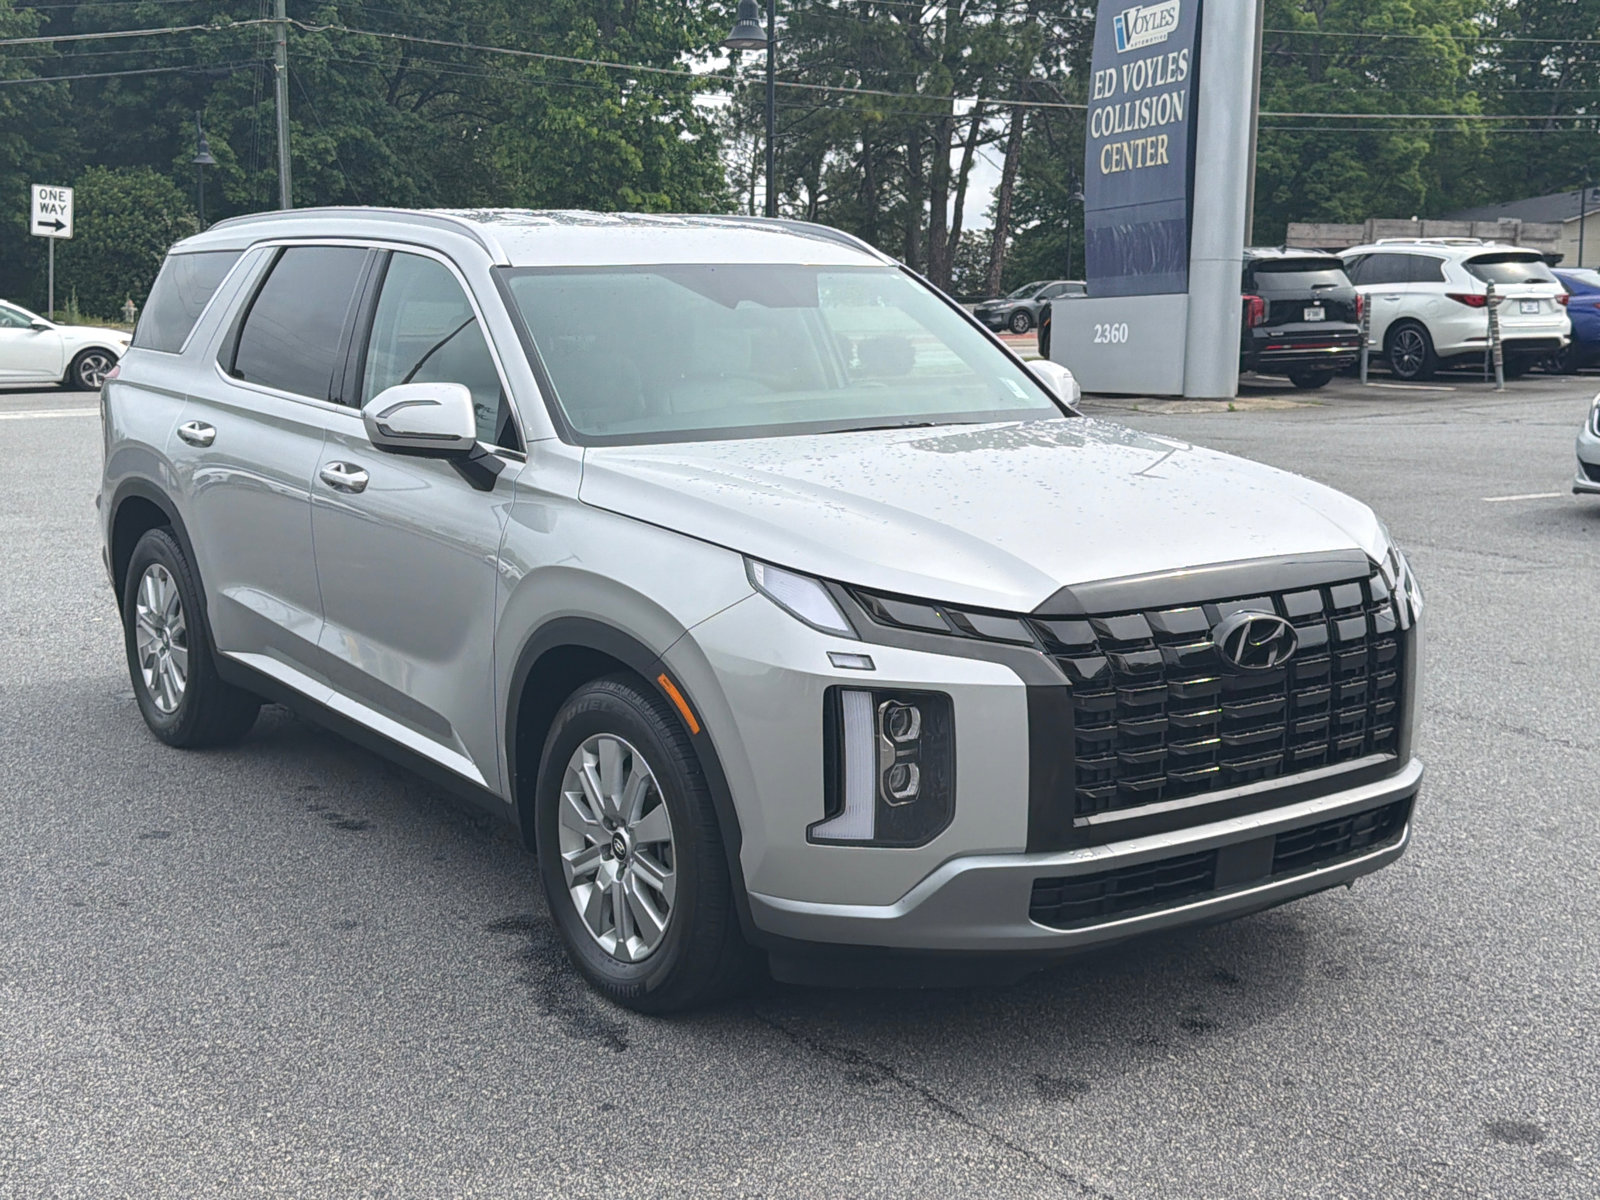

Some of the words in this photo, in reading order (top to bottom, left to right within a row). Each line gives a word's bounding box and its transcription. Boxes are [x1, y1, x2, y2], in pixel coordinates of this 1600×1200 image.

[1123, 6, 1176, 45] VOYLES
[1093, 67, 1117, 100] ED
[1122, 48, 1189, 94] VOYLES
[1091, 90, 1185, 138] COLLISION
[1100, 134, 1169, 175] CENTER
[39, 188, 66, 202] ONE
[39, 202, 67, 216] WAY
[1093, 323, 1129, 343] 2360
